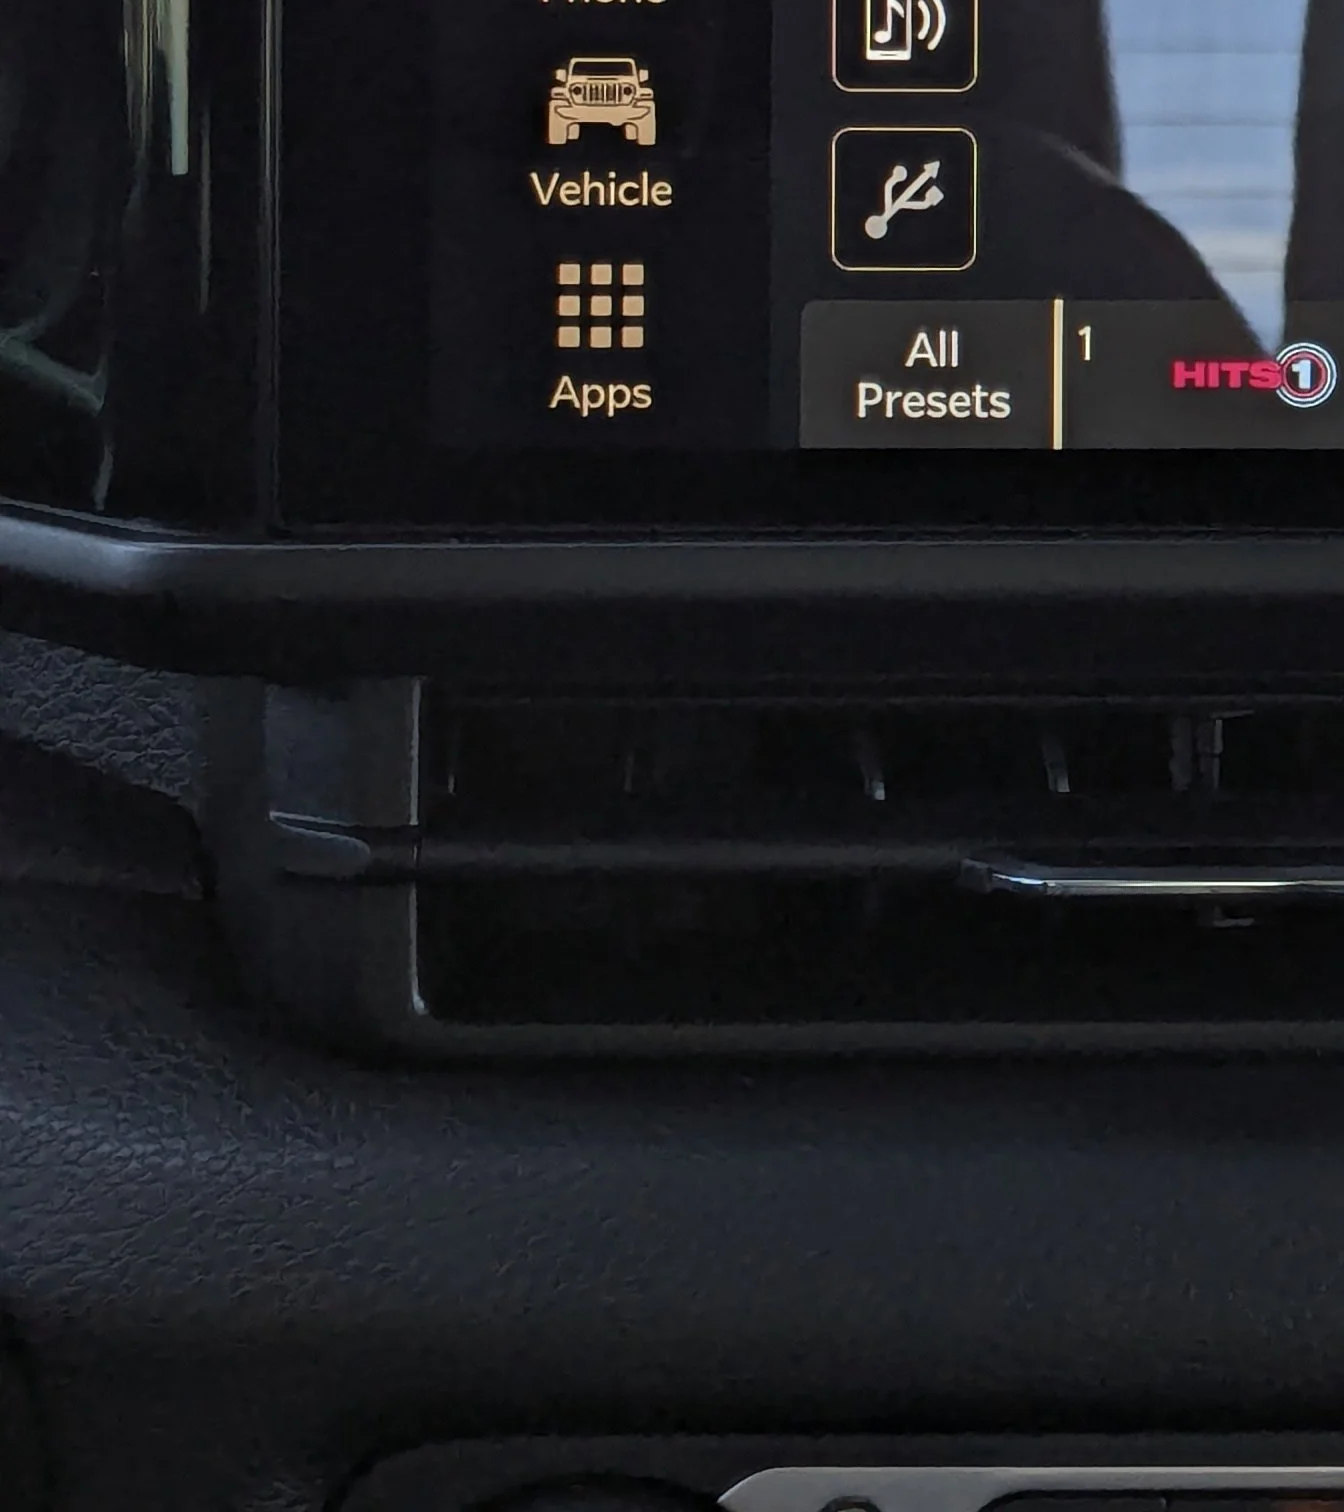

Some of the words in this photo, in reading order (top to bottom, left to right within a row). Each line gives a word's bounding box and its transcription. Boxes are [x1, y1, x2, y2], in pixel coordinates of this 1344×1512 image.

[530, 171, 673, 208] Vehicle
[904, 331, 959, 370] All
[1077, 326, 1093, 361] 1
[1172, 360, 1283, 389] HITS
[1291, 358, 1313, 390] 1
[548, 375, 654, 418] Apps
[856, 383, 1012, 420] Presets
